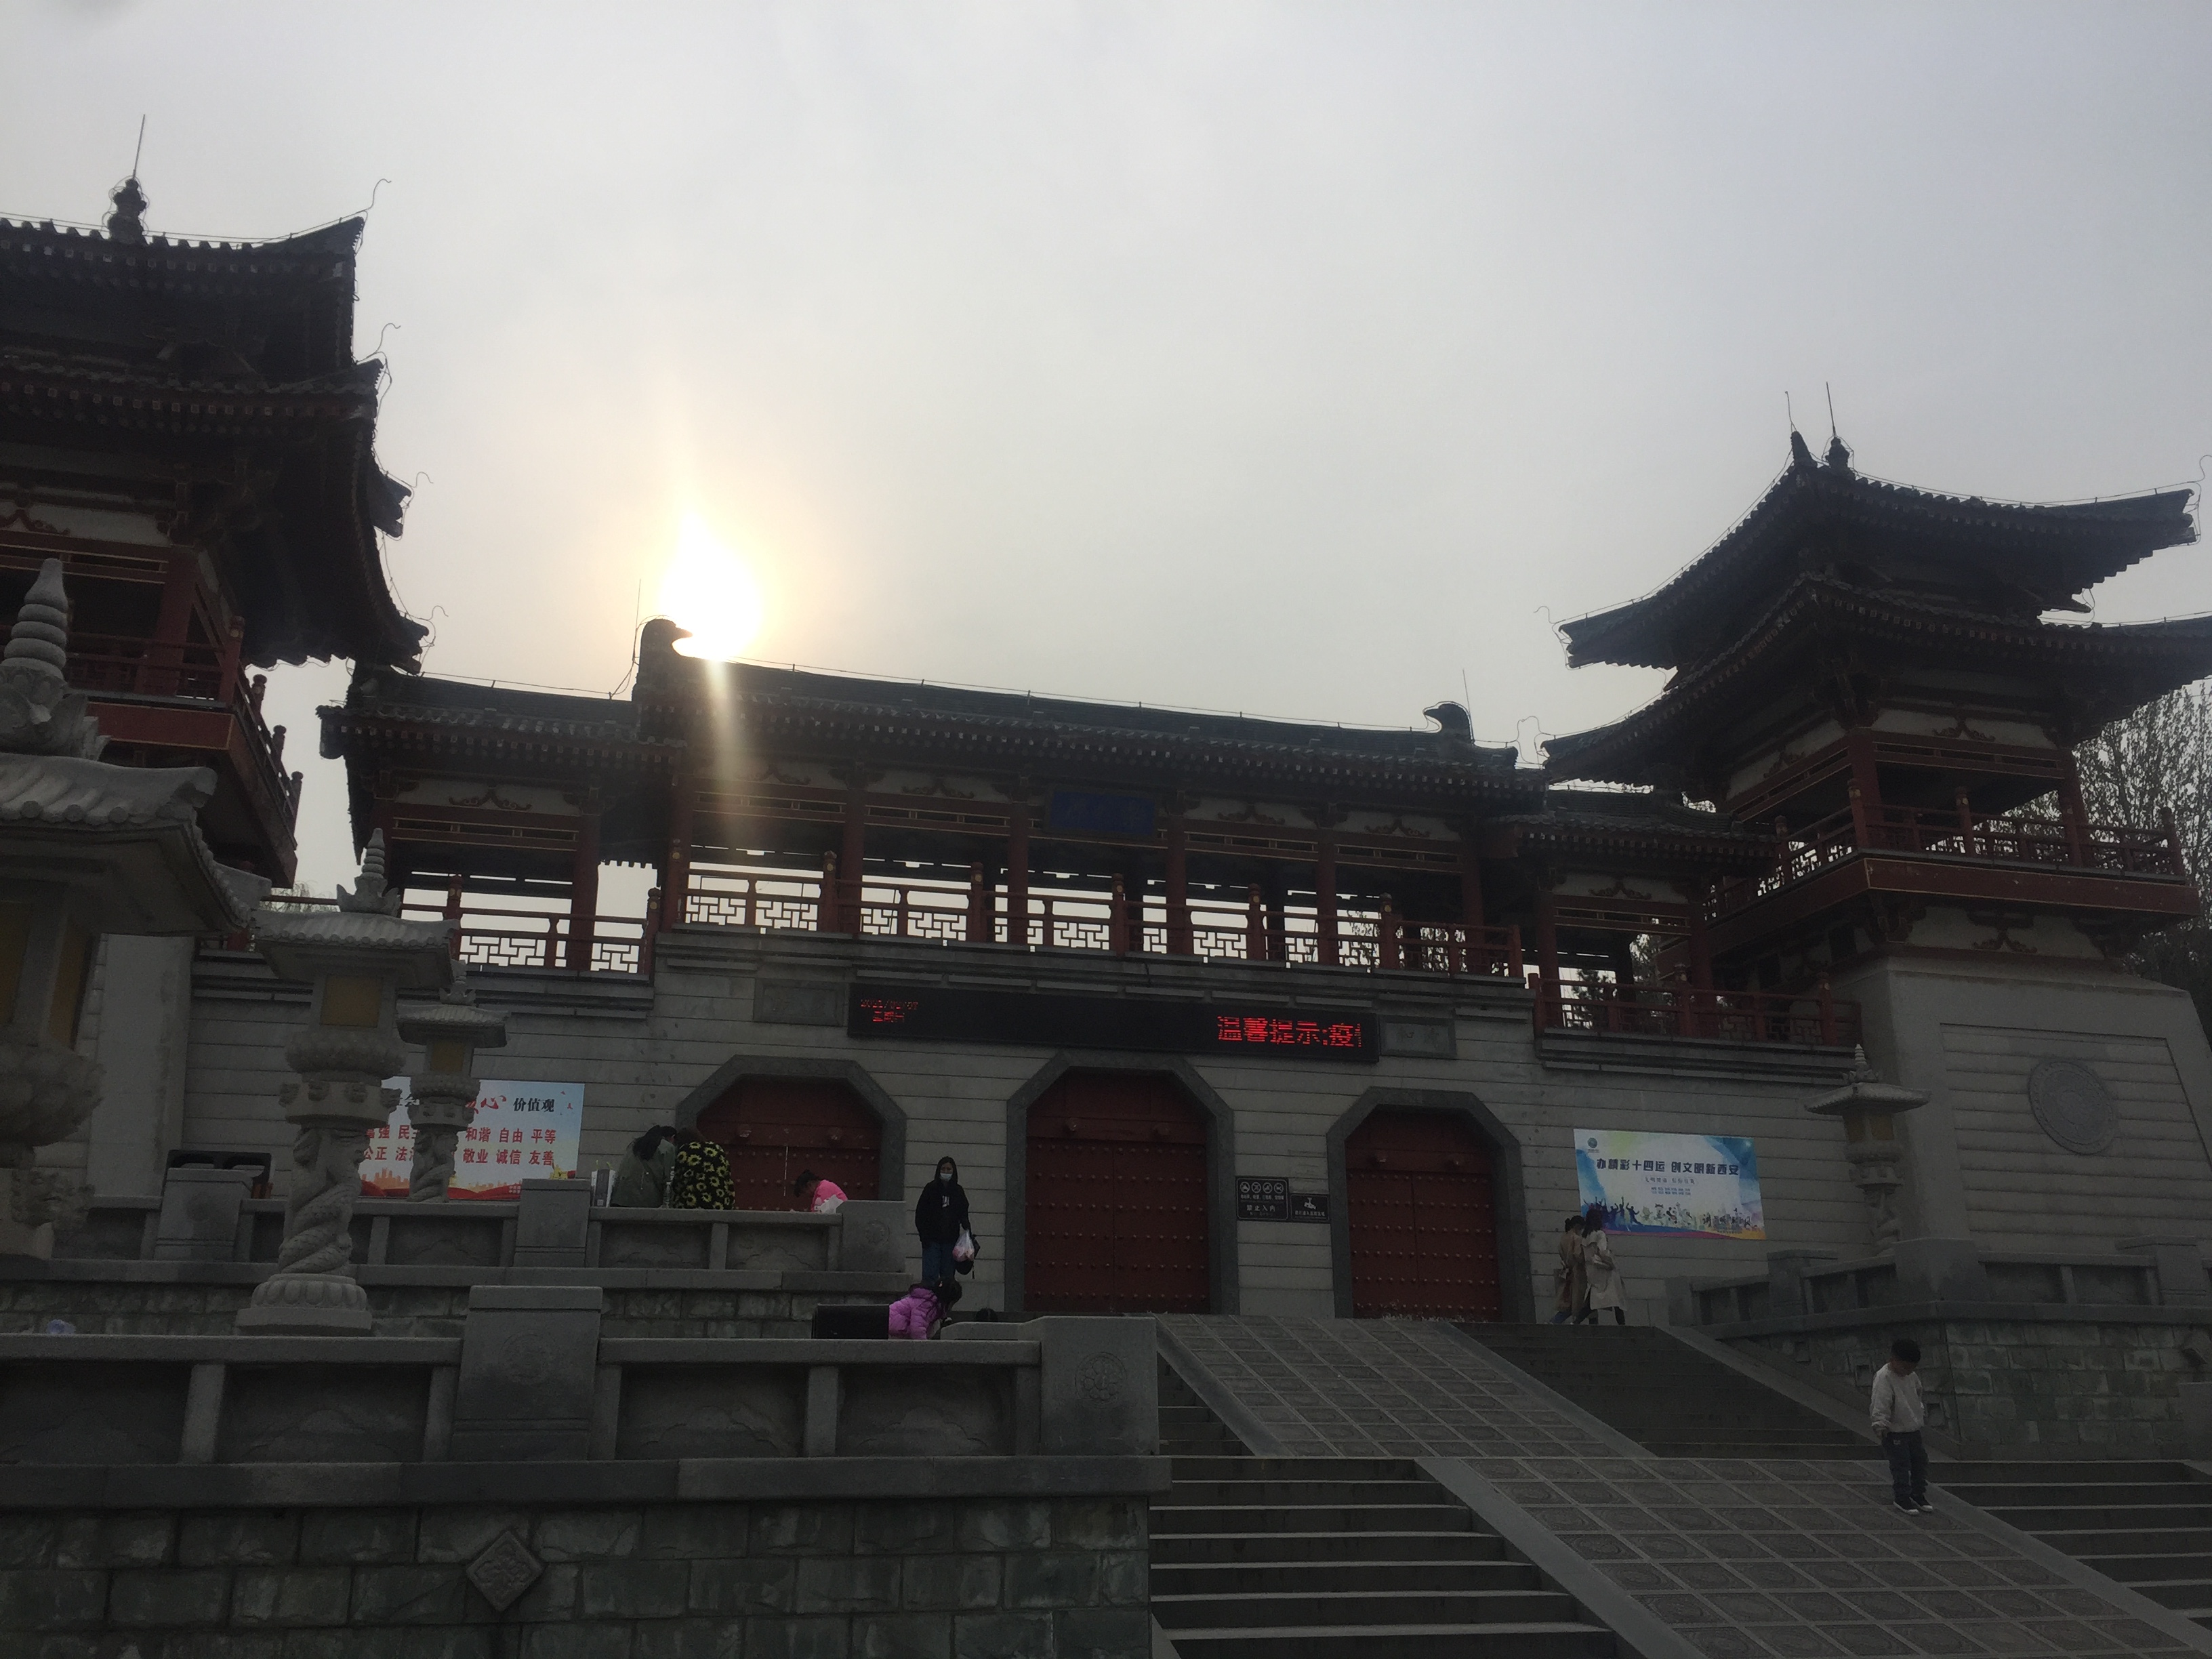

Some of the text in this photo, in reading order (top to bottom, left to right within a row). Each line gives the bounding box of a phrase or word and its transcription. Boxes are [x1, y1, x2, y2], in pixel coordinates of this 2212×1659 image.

[513, 1098, 555, 1112] 价值观
[466, 1127, 491, 1143] 和谐
[499, 1128, 523, 1143] 自由
[531, 1128, 556, 1144] 平等
[463, 1149, 489, 1164] 敬业
[496, 1149, 522, 1164] 诚信
[529, 1151, 554, 1166] 友善
[1597, 1158, 1738, 1176] 办精彩十四运 创文明新西安
